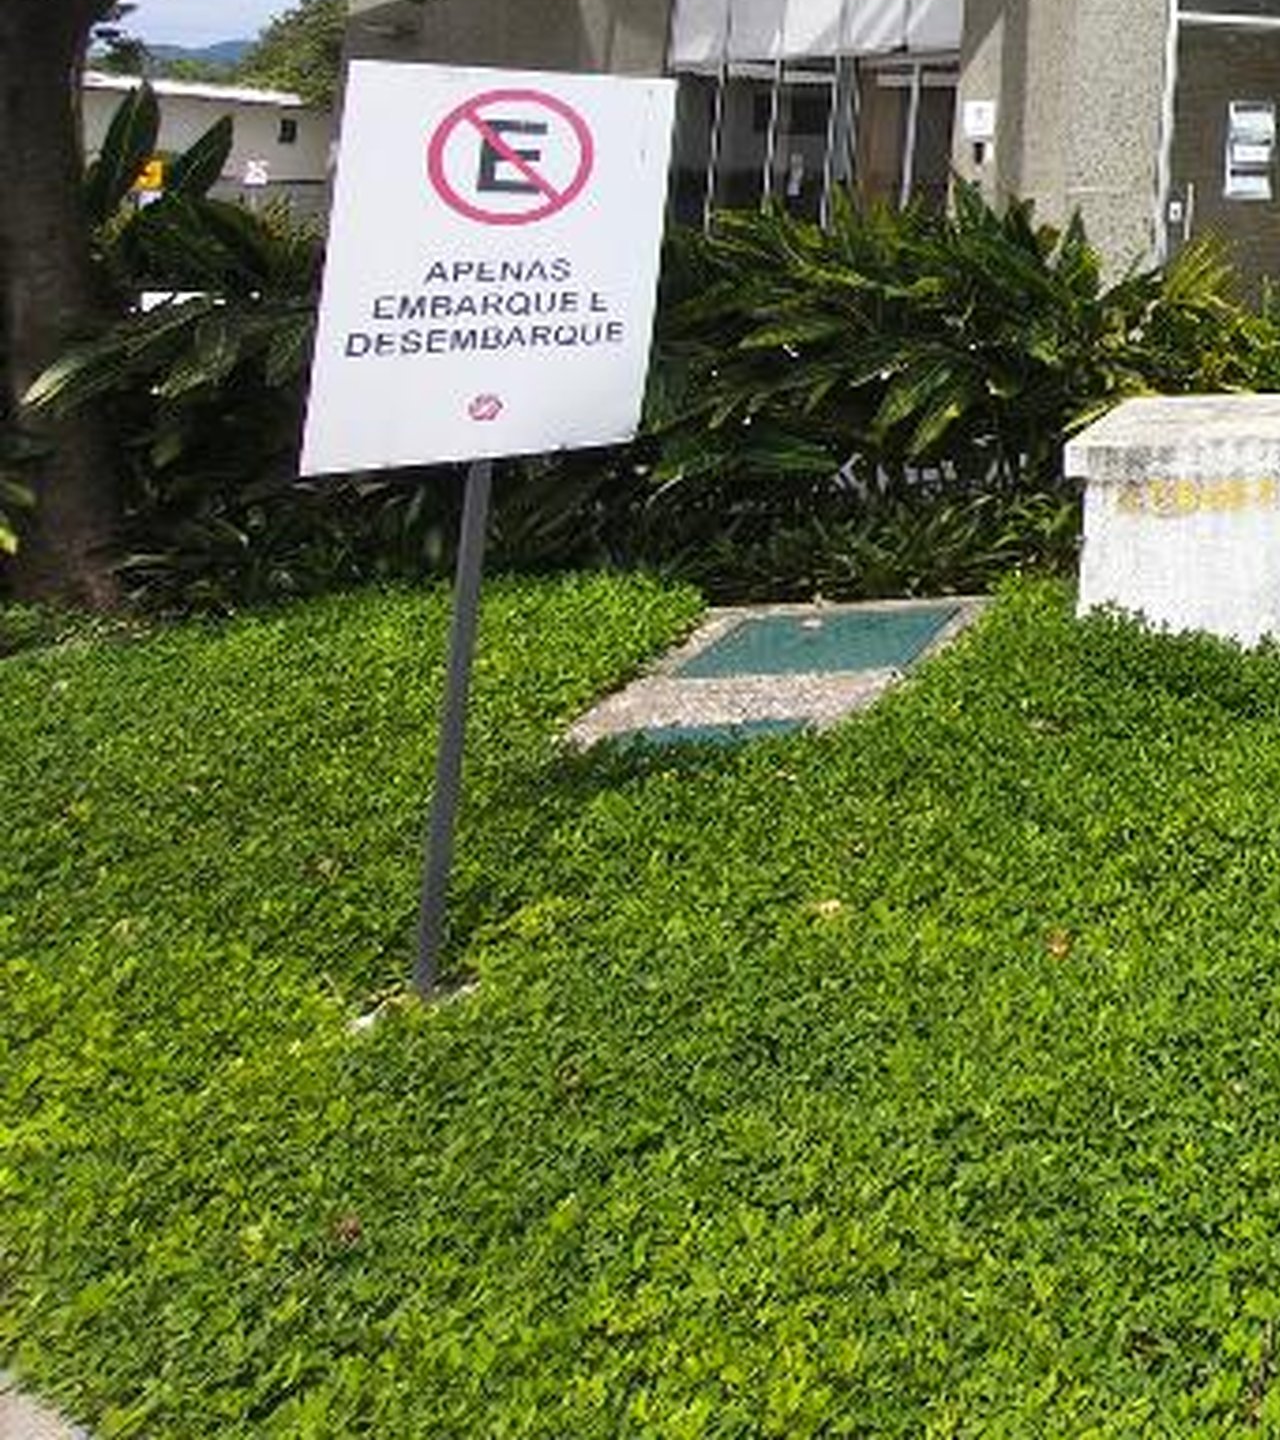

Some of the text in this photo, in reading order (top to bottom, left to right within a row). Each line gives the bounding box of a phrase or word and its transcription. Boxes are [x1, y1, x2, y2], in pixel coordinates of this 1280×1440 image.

[477, 120, 547, 194] E
[424, 258, 572, 284] APENAS
[372, 291, 609, 320] EMBARQUE E
[344, 321, 624, 357] DESEMBARQUE
